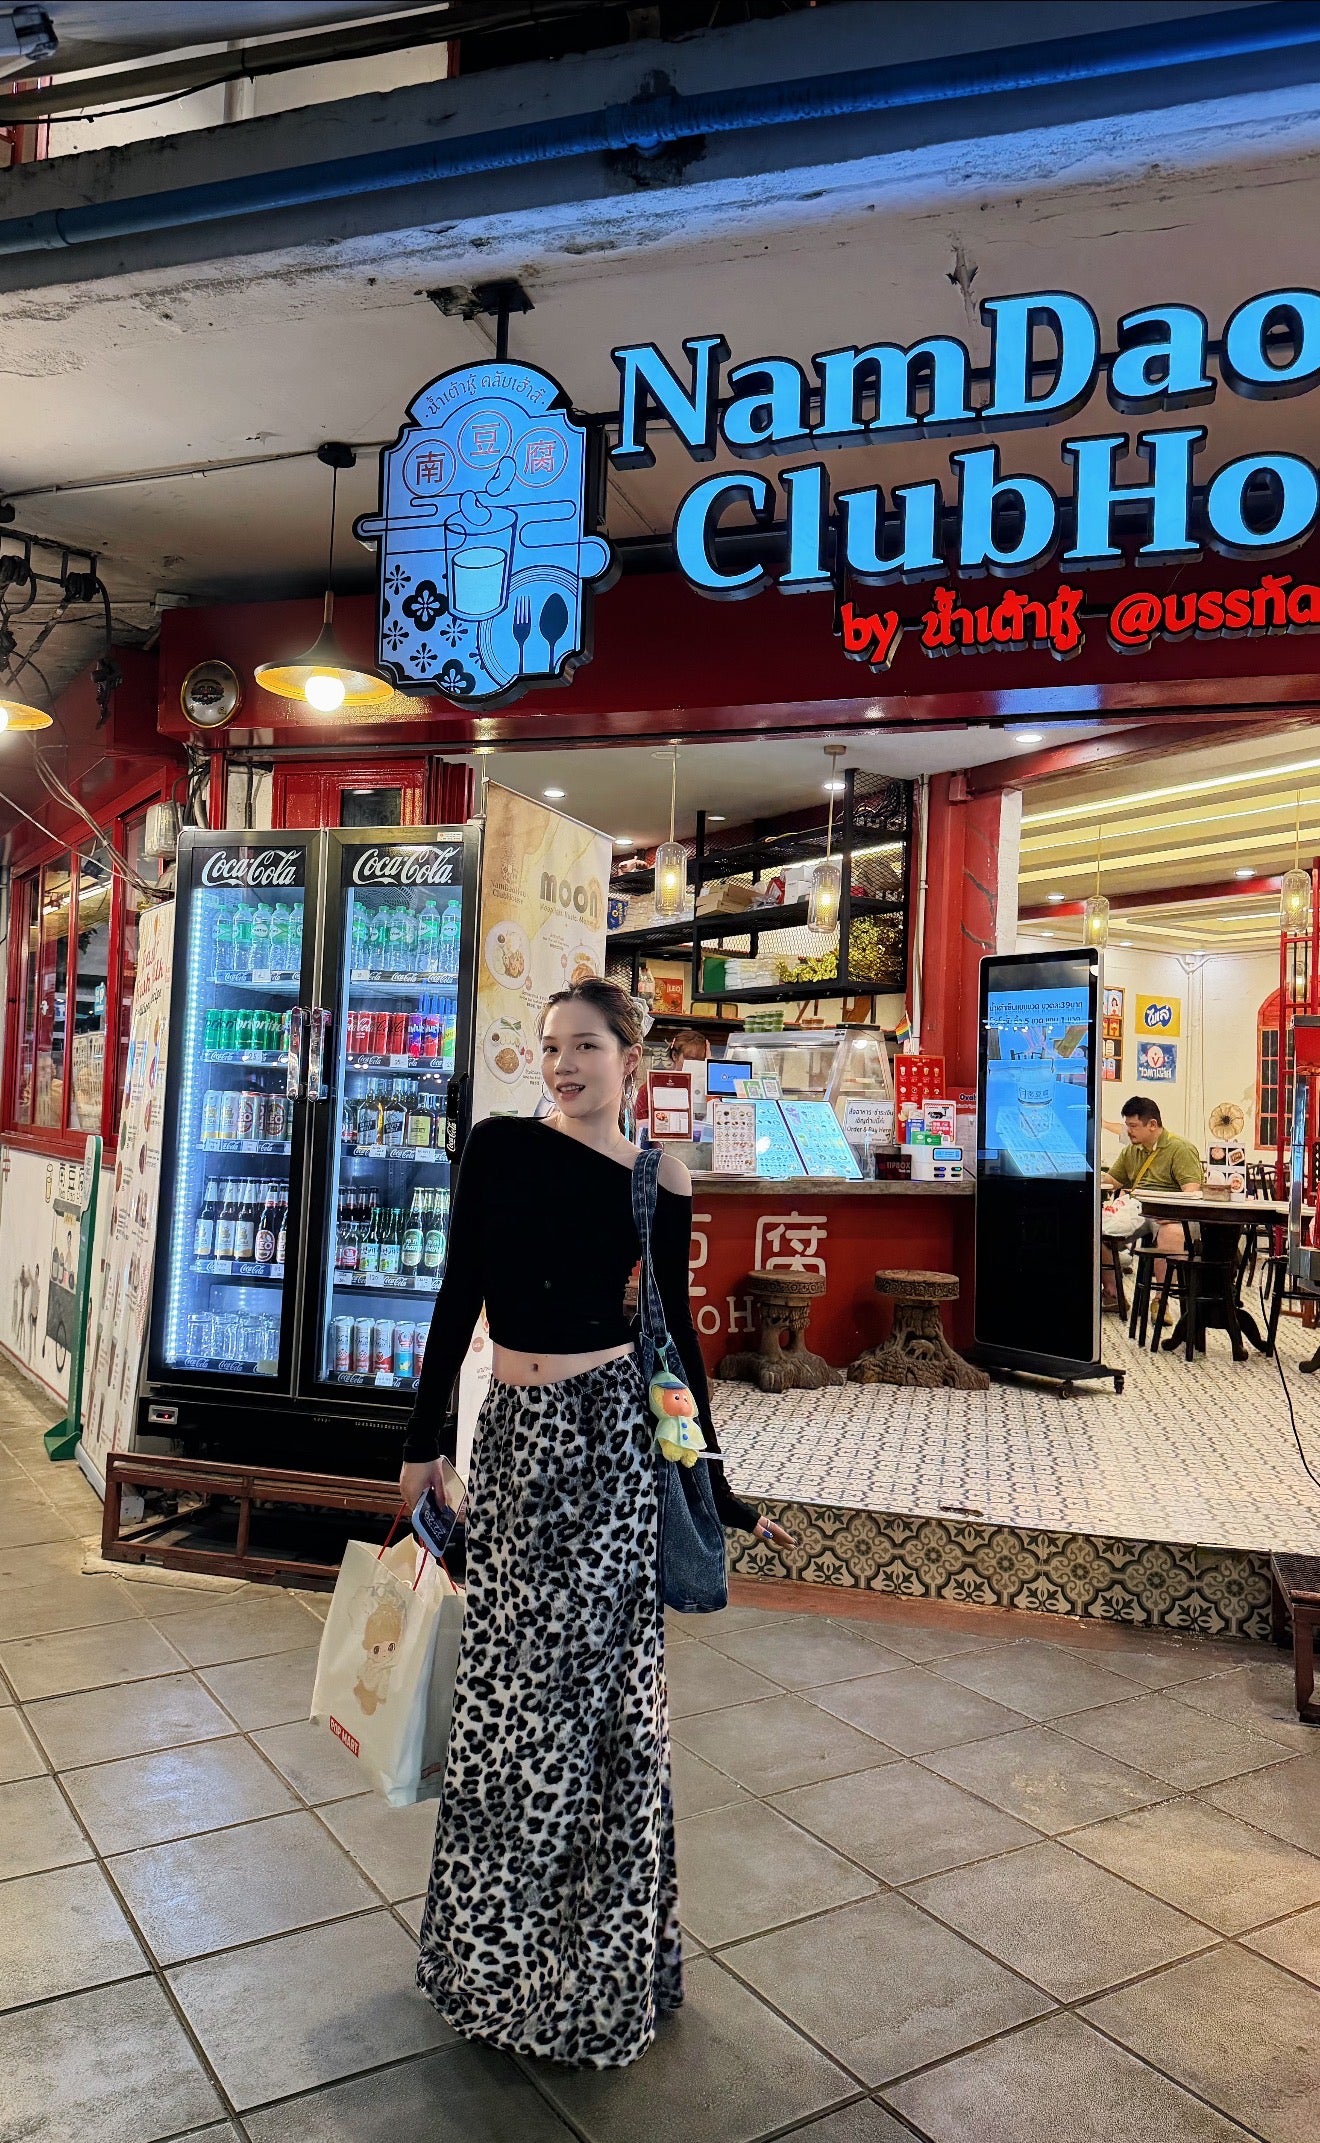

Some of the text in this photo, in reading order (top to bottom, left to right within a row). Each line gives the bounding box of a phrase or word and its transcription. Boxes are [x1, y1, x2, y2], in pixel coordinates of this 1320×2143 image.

[612, 290, 1320, 455] NamDao
[675, 427, 1319, 591] ClubHo
[840, 601, 899, 664] by
[921, 584, 1084, 652] น้ำเต้าหู้
[201, 849, 303, 887] Coca-Cola
[352, 846, 461, 885] Coca-Cola
[540, 871, 599, 919] moon
[391, 971, 419, 983] Coca-Cola
[427, 973, 455, 985] Coca-Cola
[668, 984, 681, 993] LEO
[357, 1054, 384, 1065] Coca-Cola
[446, 1118, 457, 1153] Coca-Cola
[390, 1148, 415, 1160] Coca-Cola
[240, 1263, 266, 1275] Coca-Cola
[383, 1276, 407, 1288] Coca-Cola
[337, 1372, 364, 1384] Coca-Cola
[329, 1718, 359, 1755] POP MART
